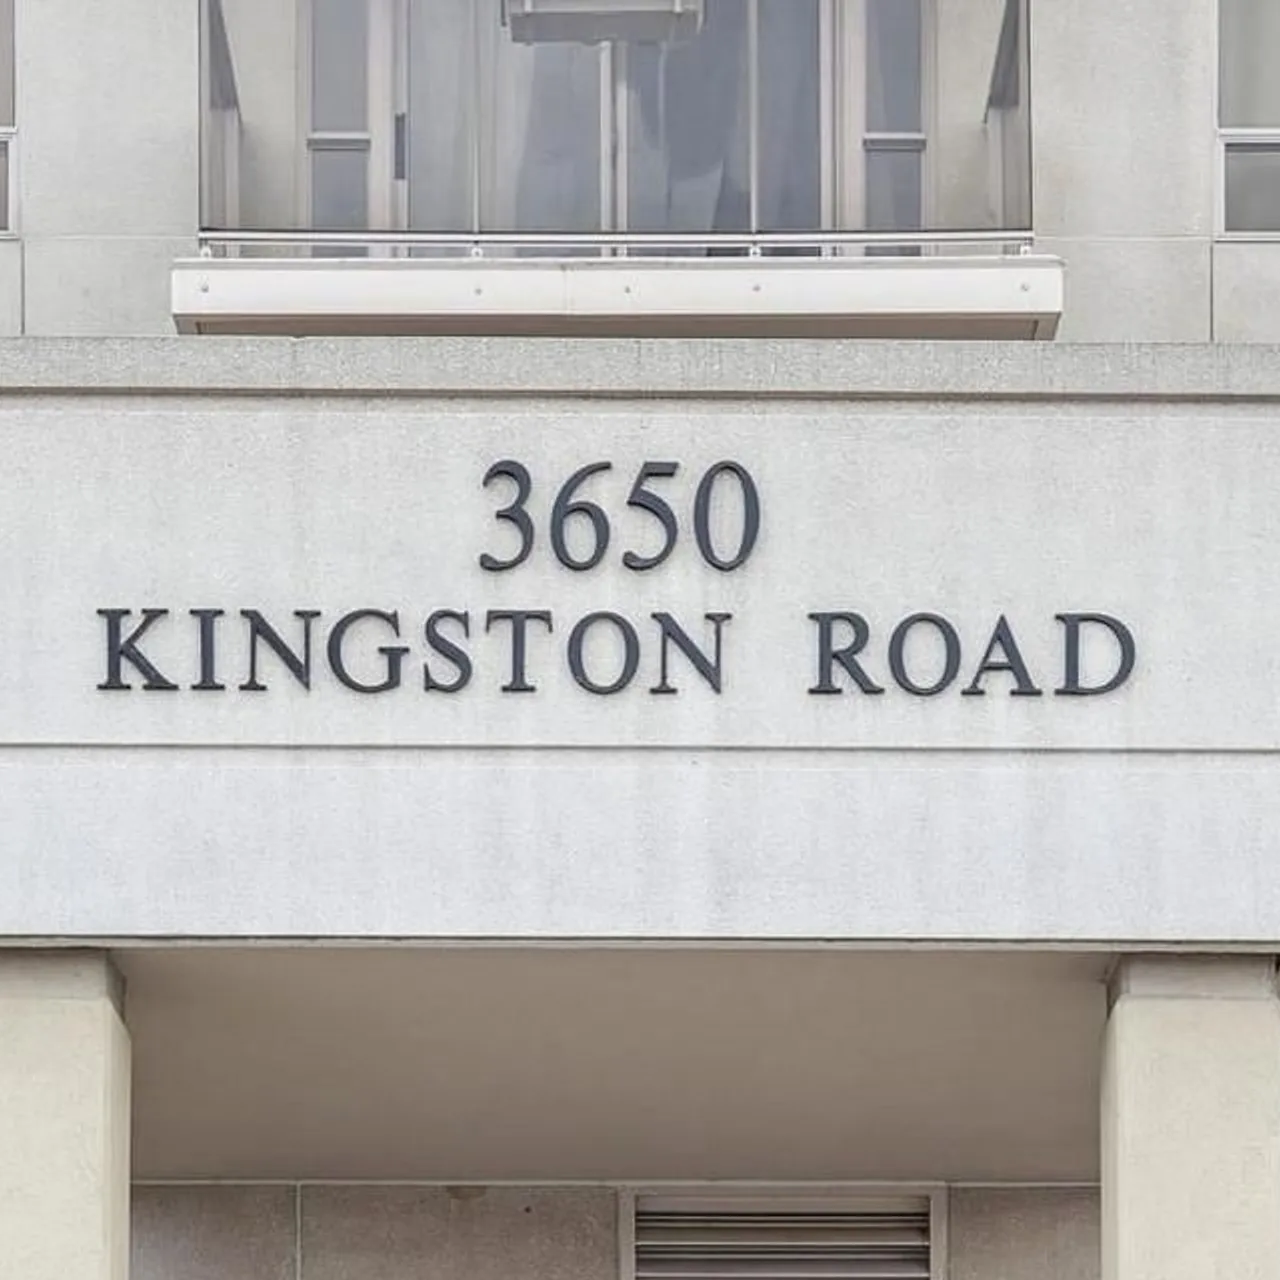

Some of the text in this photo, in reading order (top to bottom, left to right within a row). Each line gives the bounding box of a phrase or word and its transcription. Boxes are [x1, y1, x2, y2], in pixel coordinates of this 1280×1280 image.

[479, 459, 761, 573] 3650
[96, 608, 1137, 698] KINGSTON ROAD
